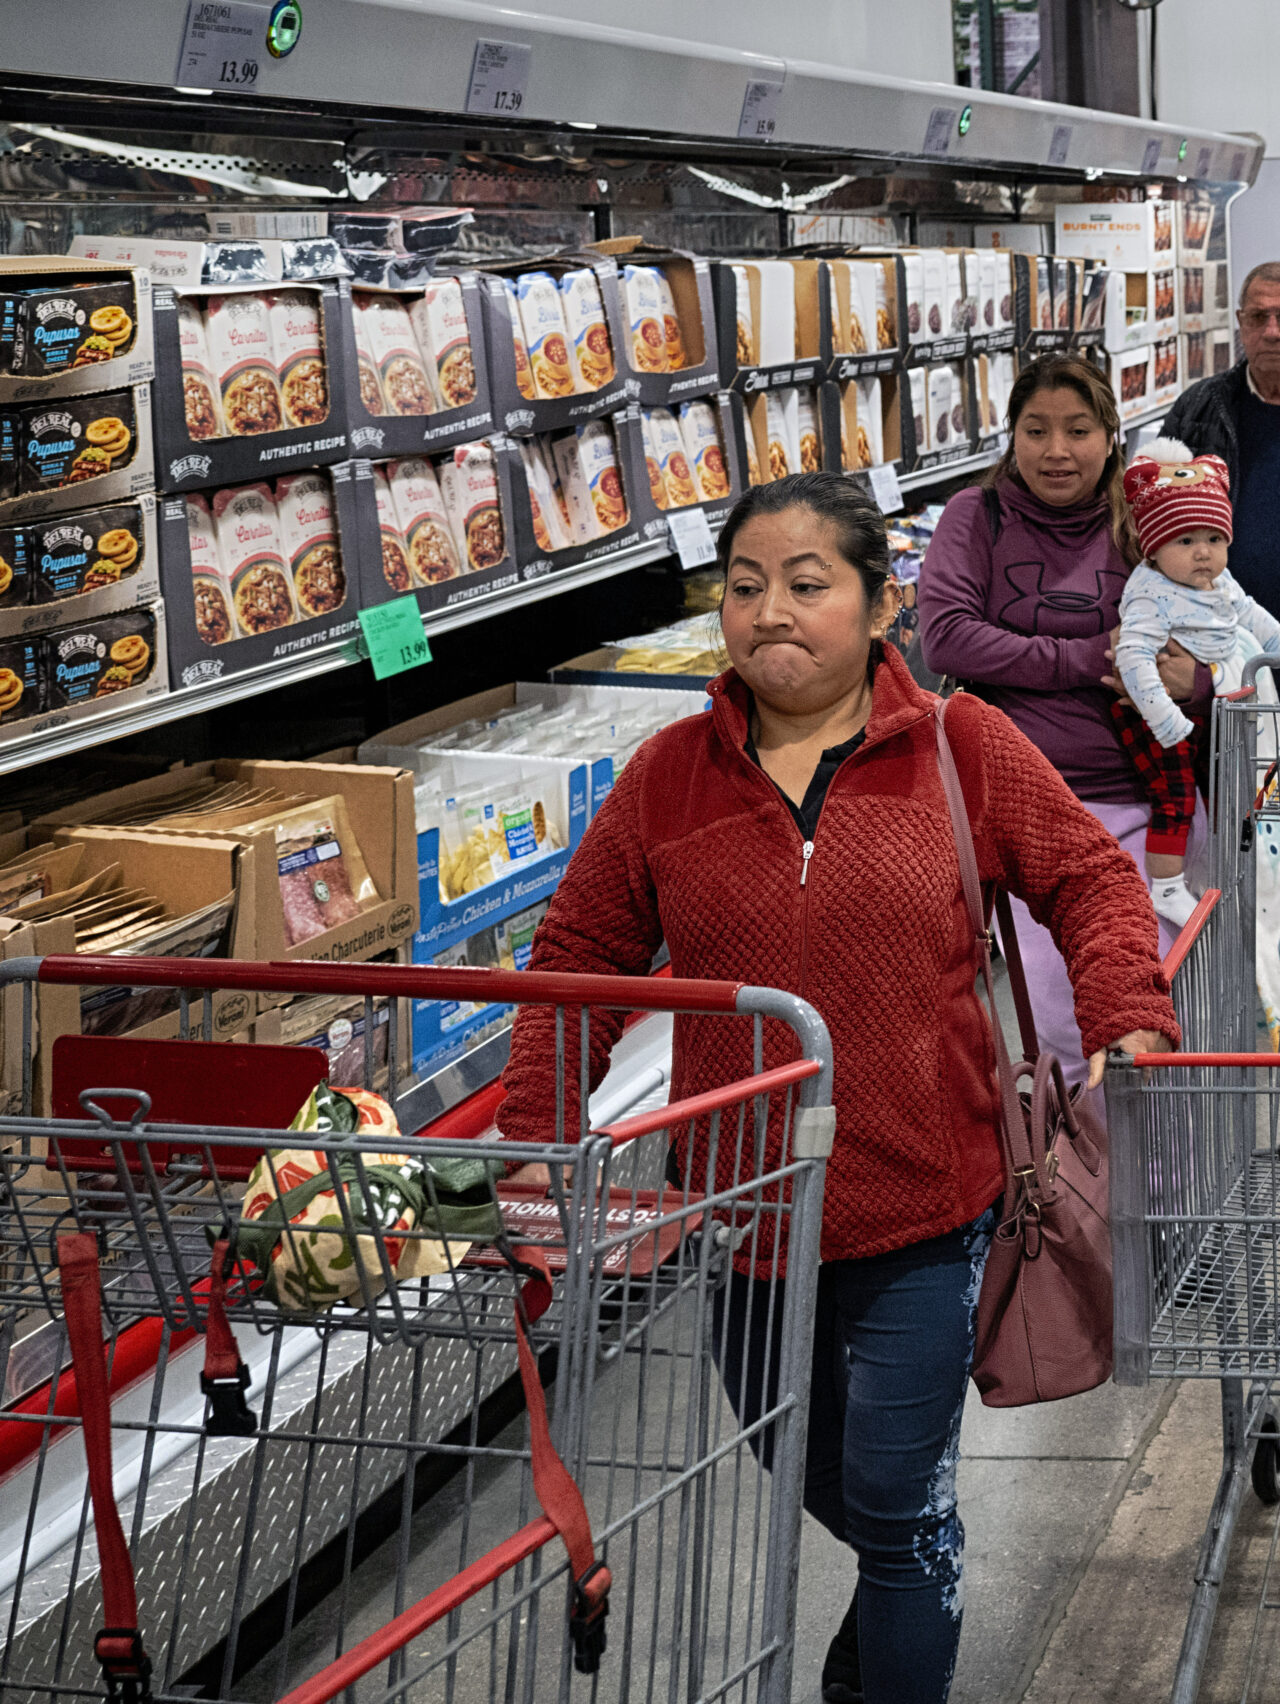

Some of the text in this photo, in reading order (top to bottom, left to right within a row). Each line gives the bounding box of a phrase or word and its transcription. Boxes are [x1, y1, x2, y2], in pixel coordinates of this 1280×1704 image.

[219, 61, 258, 84] 13.99
[1063, 223, 1141, 232] BURNT ENDS
[34, 326, 80, 346] Pupusas
[568, 398, 605, 416] AUTHENTIC
[424, 412, 492, 440] AUTHENTIC RECIPE
[28, 440, 76, 459] Pupusas
[260, 436, 346, 462] AUTHENTIC RECIPE
[584, 541, 620, 560] AUTHENTIC
[41, 553, 88, 574] Pupusas
[447, 573, 520, 604] AUTHENTIC RECIPE
[273, 632, 327, 656] AUTHENTIC
[328, 619, 361, 638] RECIPE
[400, 640, 426, 665] 13.99
[56, 660, 101, 682] Pupusas
[184, 664, 223, 684] DEL REAL
[462, 898, 501, 924] Chicken
[504, 890, 511, 904] &
[512, 866, 561, 900] Mozzarella
[332, 924, 385, 962] Charcuterie
